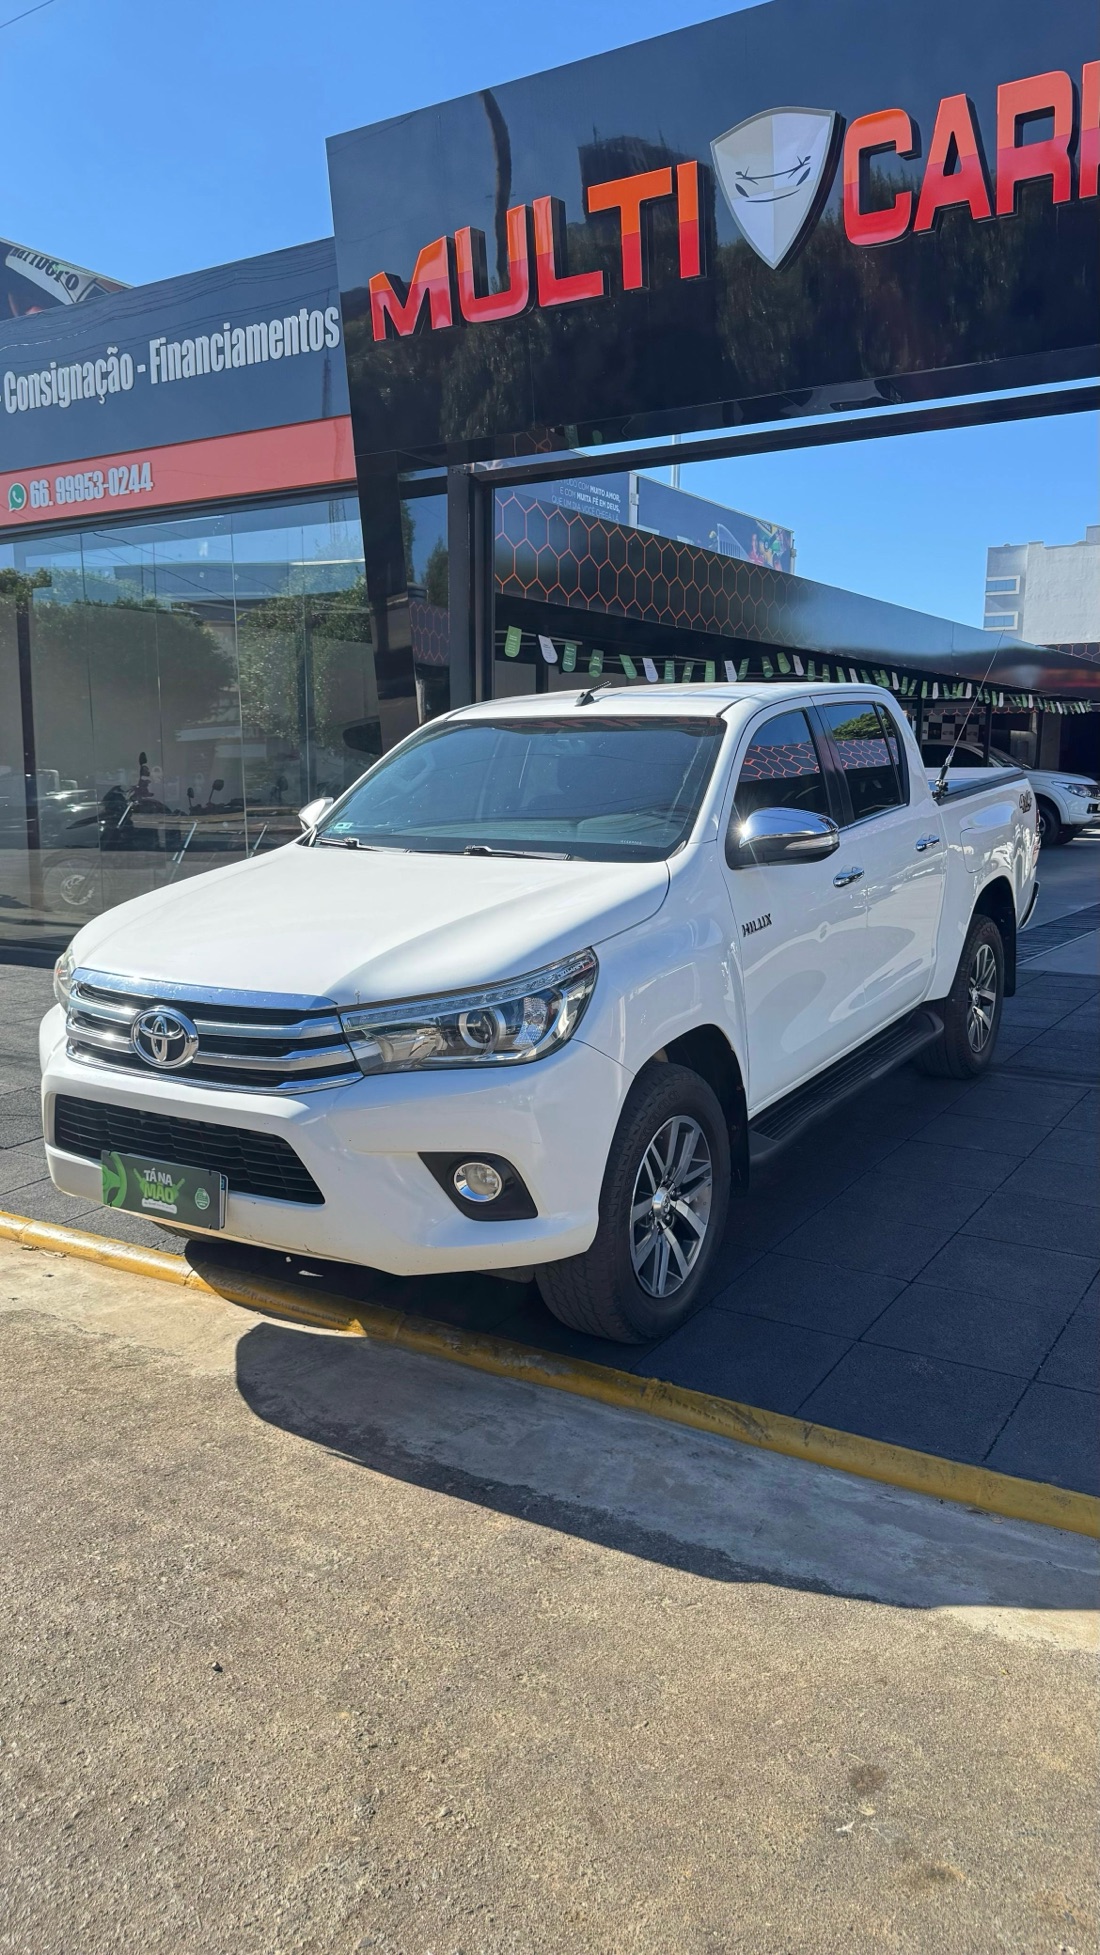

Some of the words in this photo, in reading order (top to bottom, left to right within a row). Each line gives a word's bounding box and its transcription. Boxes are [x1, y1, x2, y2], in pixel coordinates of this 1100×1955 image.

[368, 160, 704, 342] MULTI
[842, 60, 1100, 247] CAR
[3, 346, 134, 414] Consignação
[149, 306, 341, 385] Financiamentos
[29, 479, 55, 509] 66.
[55, 461, 154, 505] 99953-0244
[589, 485, 605, 498] MUITO
[605, 491, 621, 504] AMOR,
[576, 491, 592, 504] MUITA
[606, 501, 621, 514] DEUS,
[741, 912, 772, 938] HILUX
[143, 1167, 157, 1182] TÁ
[157, 1171, 173, 1187] NA
[143, 1180, 175, 1205] MÃO
